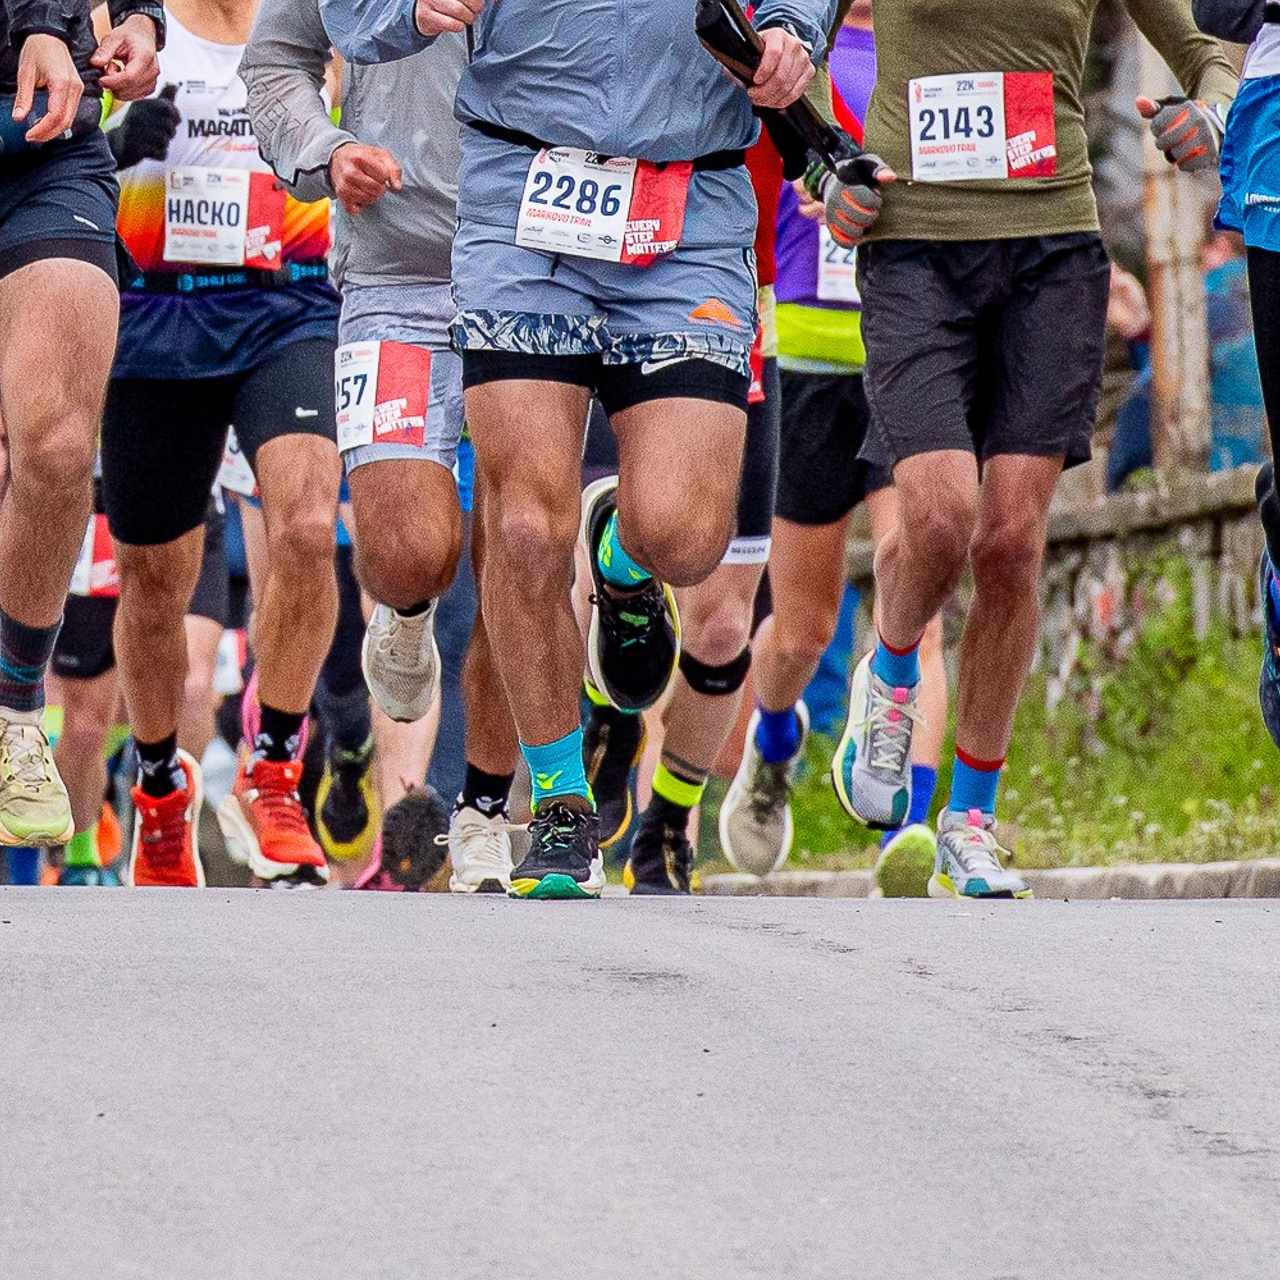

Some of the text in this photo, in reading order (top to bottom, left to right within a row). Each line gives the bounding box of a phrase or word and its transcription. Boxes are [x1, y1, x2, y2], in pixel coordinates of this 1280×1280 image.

[957, 80, 974, 91] 22K
[919, 105, 995, 141] 2143
[918, 143, 977, 155] MARKOVO TRAIL
[529, 171, 622, 217] 2286
[526, 208, 592, 227] MARKOVO TRAIL
[626, 219, 661, 233] EVERY
[625, 231, 654, 244] STEP
[626, 240, 678, 256] MATTERS
[336, 374, 368, 412] 57
